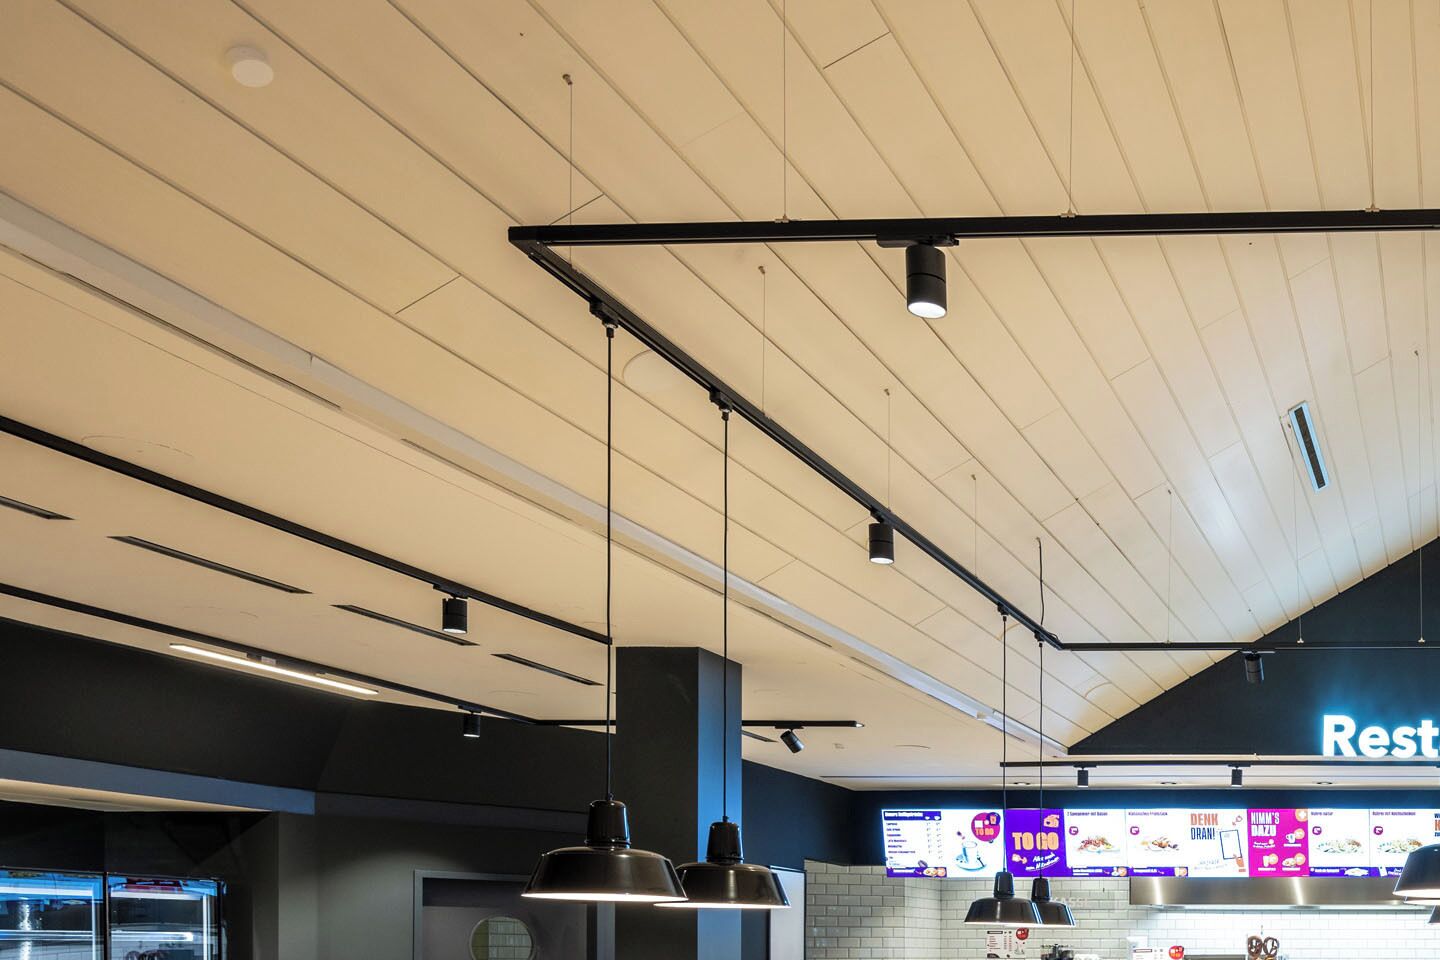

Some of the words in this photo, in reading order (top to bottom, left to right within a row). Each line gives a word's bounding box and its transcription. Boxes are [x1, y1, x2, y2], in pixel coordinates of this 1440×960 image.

[1190, 813, 1219, 826] DENK
[1190, 827, 1216, 840] DRAN!
[1251, 824, 1277, 836] DAZU
[1012, 832, 1034, 850] TO
[1036, 832, 1059, 850] GO
